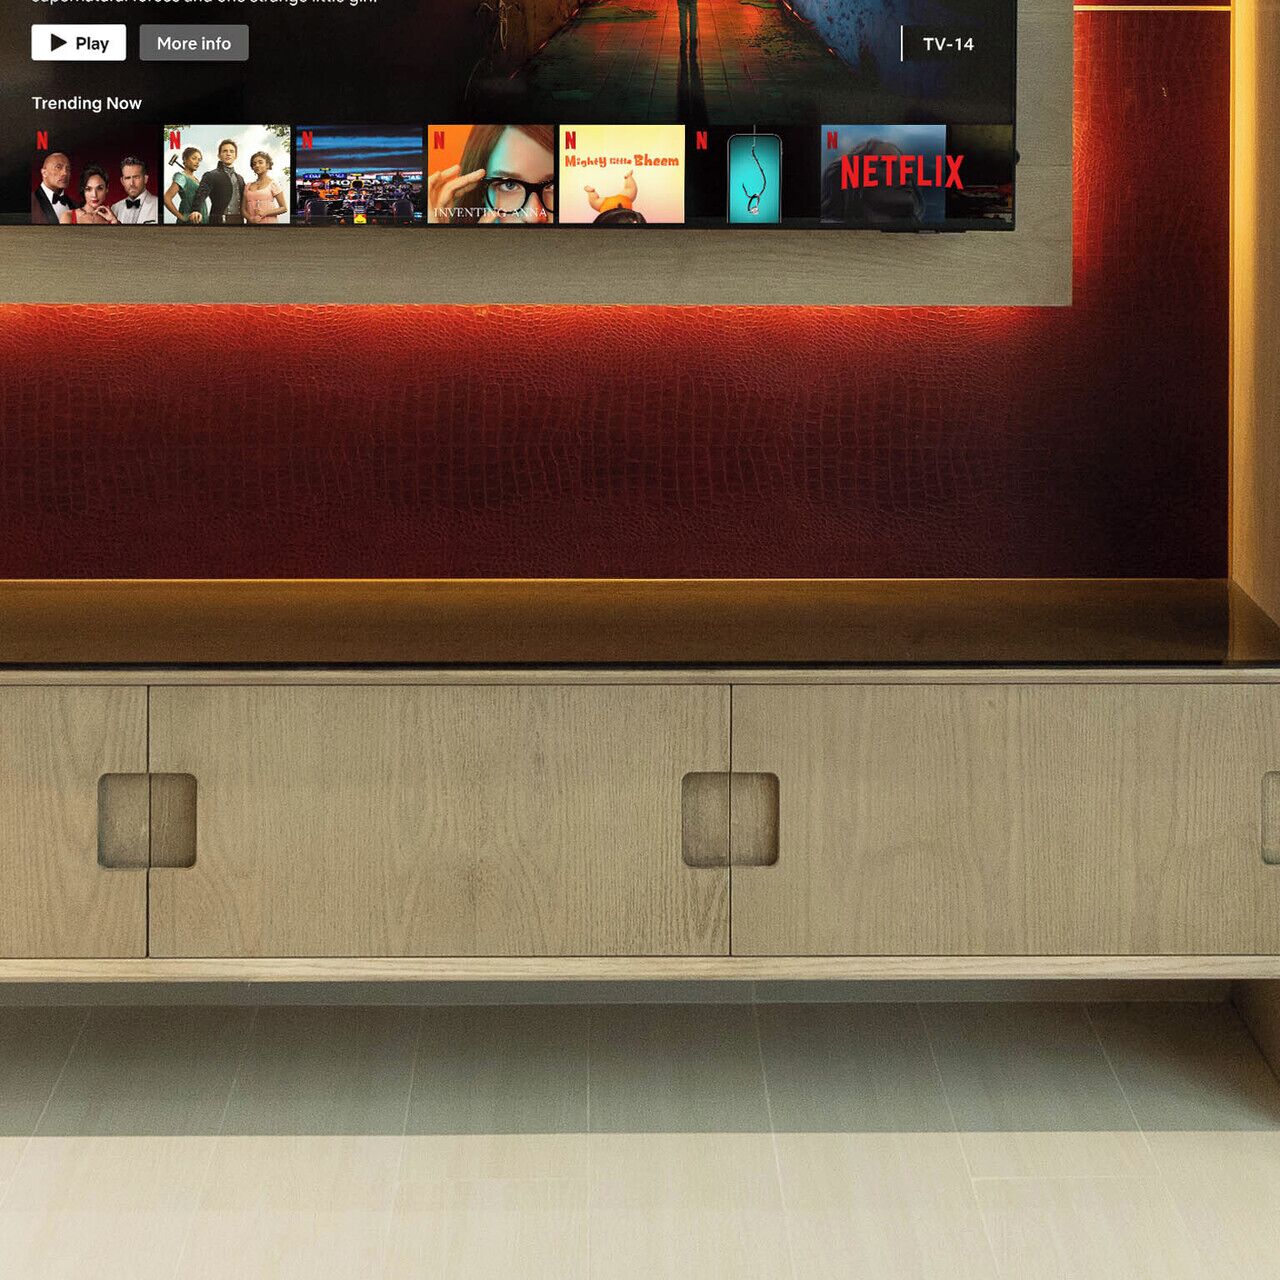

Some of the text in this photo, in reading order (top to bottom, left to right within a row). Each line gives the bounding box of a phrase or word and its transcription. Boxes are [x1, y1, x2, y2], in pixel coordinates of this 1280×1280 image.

[76, 36, 110, 54] Play
[157, 36, 232, 51] More info
[922, 37, 975, 51] TV-14
[31, 95, 143, 114] Trending Now
[37, 131, 48, 149] N
[170, 131, 180, 149] N
[302, 131, 313, 149] N
[434, 131, 444, 149] N
[565, 131, 576, 149] N
[696, 131, 707, 149] N
[827, 131, 838, 149] N
[565, 155, 607, 168] Mighty
[634, 153, 680, 167] Bheem
[840, 155, 964, 190] NETFLIX
[434, 207, 548, 218] INVENTING ANNA
